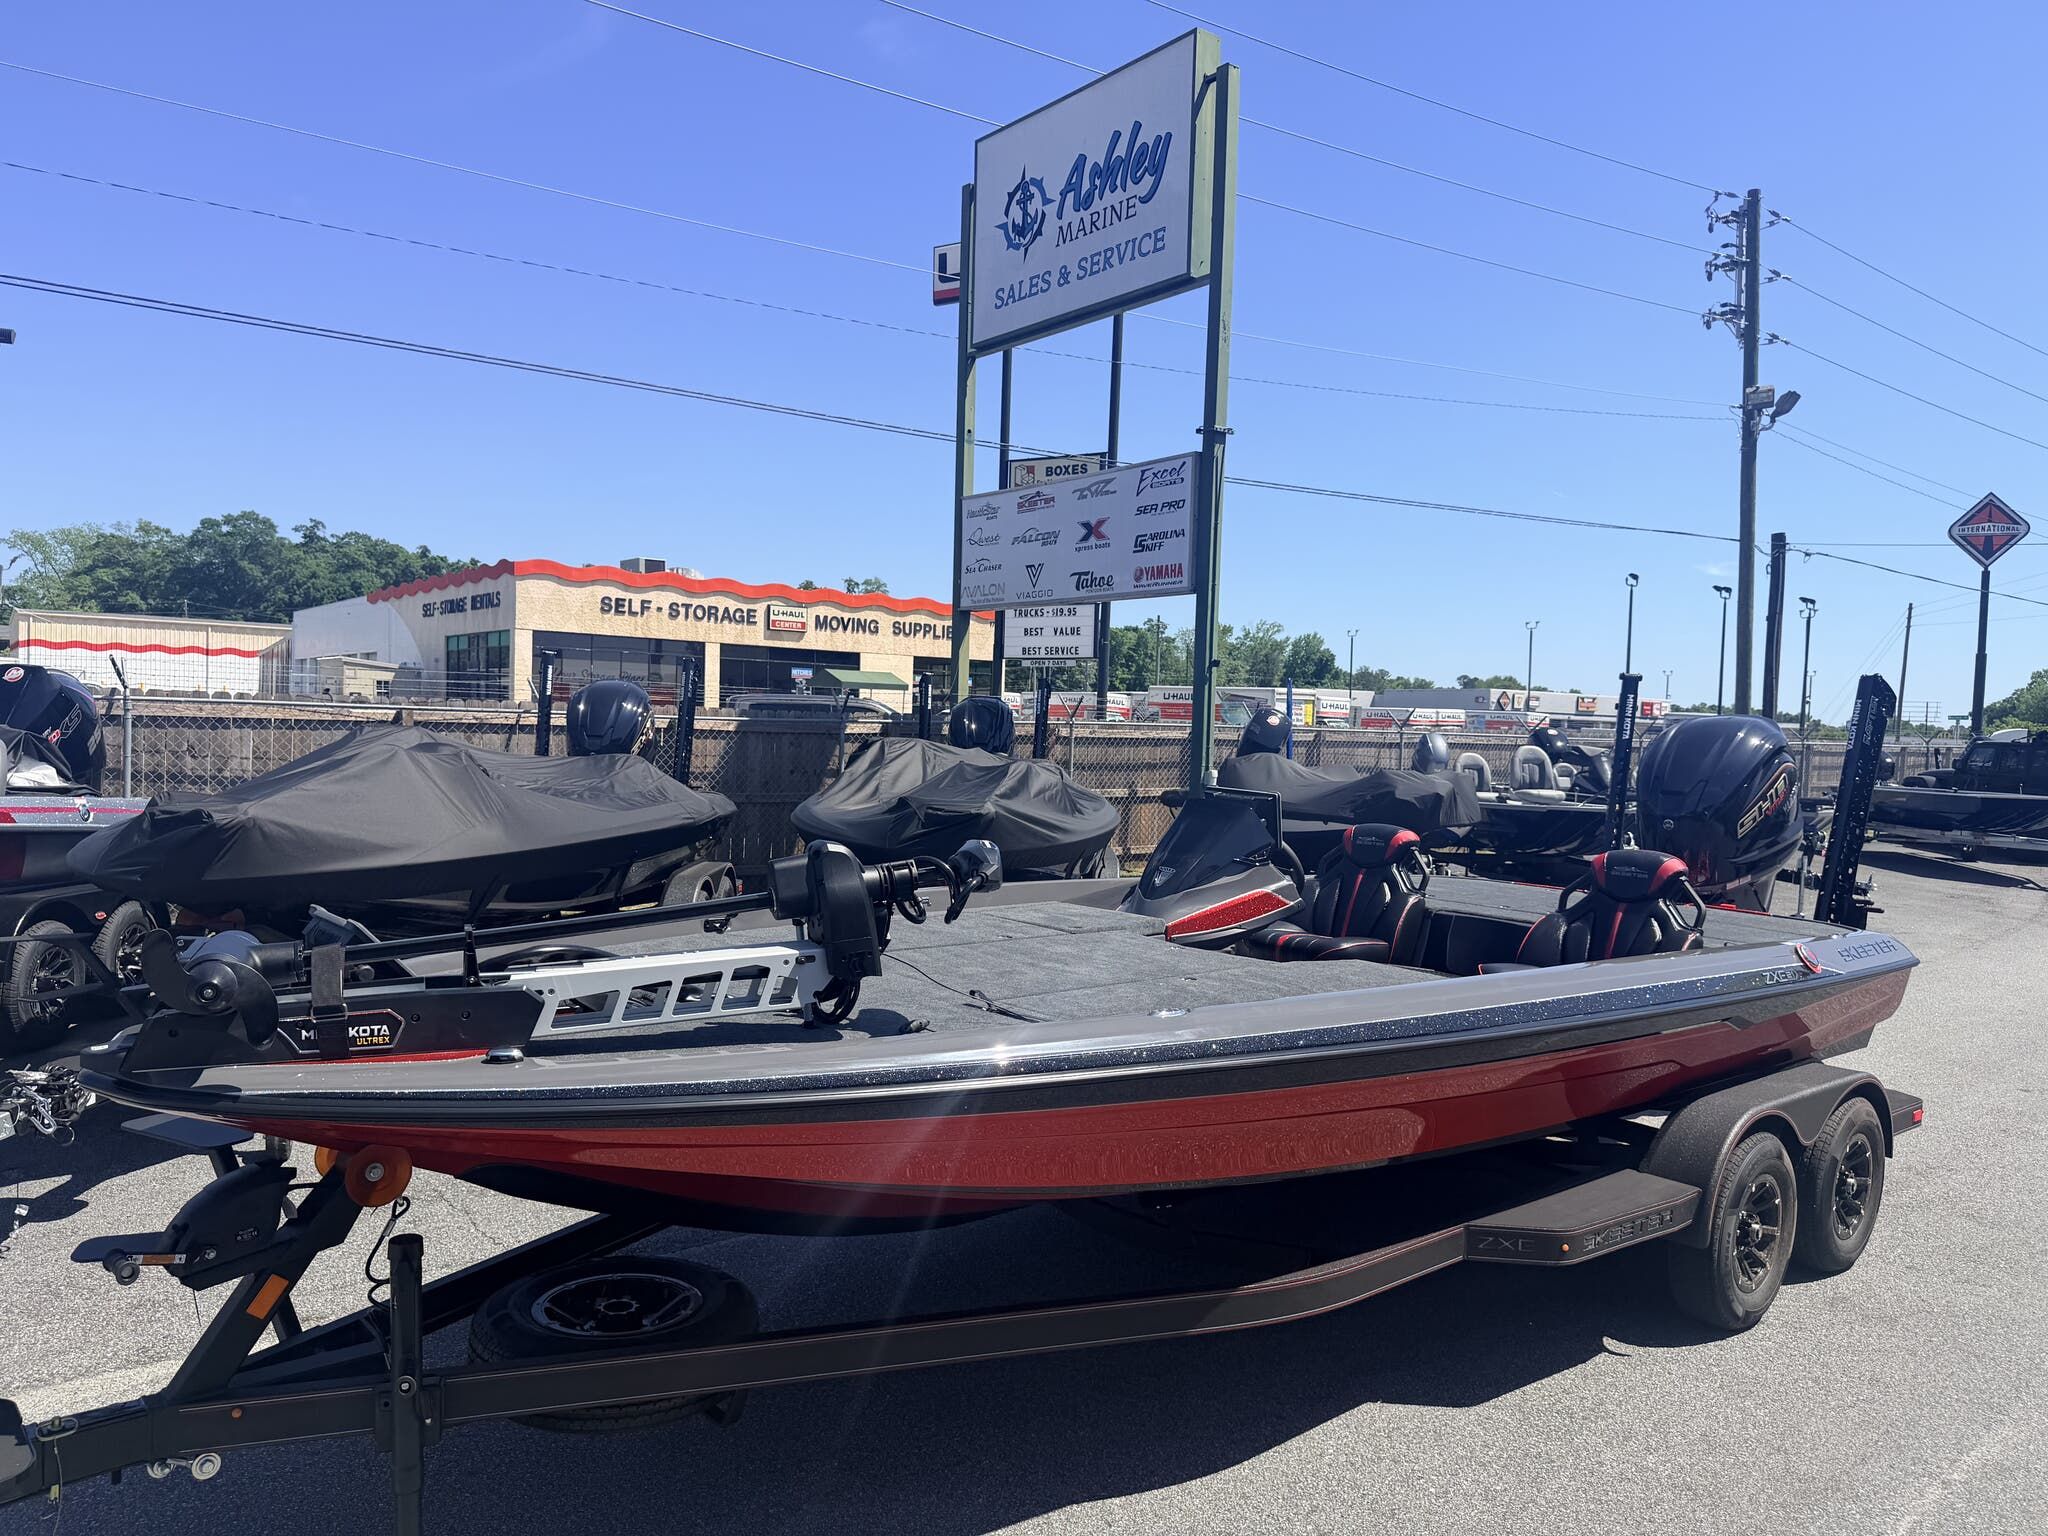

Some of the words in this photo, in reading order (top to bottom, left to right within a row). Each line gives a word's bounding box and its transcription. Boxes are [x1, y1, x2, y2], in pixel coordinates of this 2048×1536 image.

[1056, 120, 1172, 220] Ashley
[1056, 195, 1139, 248] MARINE
[994, 270, 1051, 311] SALES
[1057, 265, 1071, 288] &
[1076, 226, 1167, 281] SERVICE
[1045, 463, 1088, 477] BOXES
[1136, 460, 1187, 497] Excel
[1134, 503, 1159, 516] SEA
[1160, 499, 1186, 512] PRO
[1957, 524, 2021, 534] INTERNATIONAL
[1069, 570, 1115, 592] Tahoe
[1144, 563, 1184, 581] YAMAHA
[961, 581, 1006, 600] AVALON
[1016, 589, 1054, 600] VIAGGIO
[772, 609, 805, 619] U-HAUL
[1013, 608, 1045, 618] TRUCKS
[1051, 607, 1077, 617] $19.95
[775, 621, 802, 629] CENTER
[815, 614, 880, 635] MOVING
[892, 620, 953, 640] SUPPLIE
[1023, 627, 1044, 637] BEST
[1053, 626, 1081, 637] VALUE
[1021, 647, 1042, 656] BEST
[1044, 646, 1080, 656] SERVICE
[1625, 694, 1635, 717] MINN
[1852, 699, 1863, 725] MINN
[1622, 717, 1632, 739] KOTA
[1847, 725, 1857, 750] KOTA
[1838, 939, 1897, 963] SKEETER
[348, 1024, 390, 1038] KOTA
[356, 1036, 390, 1045] ULTREX
[1583, 1208, 1674, 1252] SKEETER
